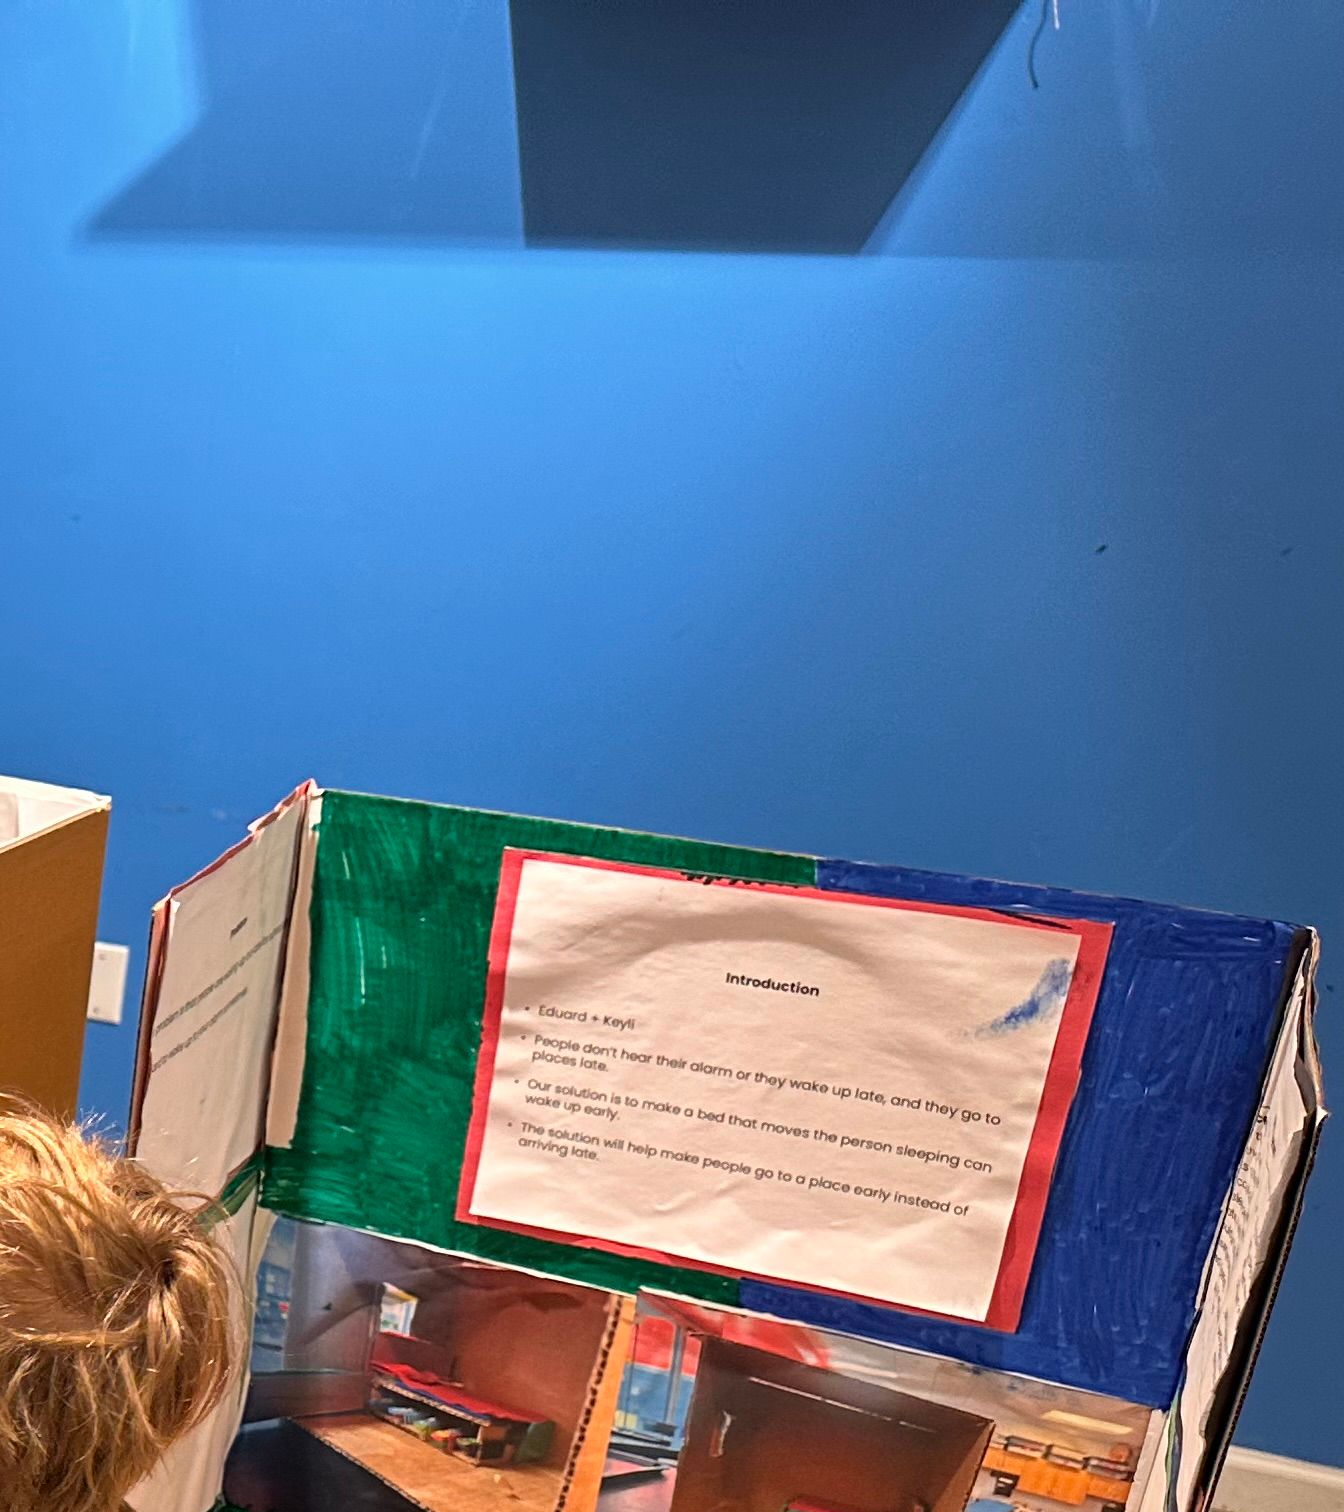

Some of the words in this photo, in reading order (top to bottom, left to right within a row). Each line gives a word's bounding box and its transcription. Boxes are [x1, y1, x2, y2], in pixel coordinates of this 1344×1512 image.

[725, 972, 820, 997] Introduction
[537, 1003, 588, 1022] Eduard
[603, 1016, 635, 1031] Keyli
[532, 1050, 576, 1066] places
[580, 1058, 608, 1072] late.
[534, 1033, 581, 1052] People
[582, 1043, 618, 1059] don't
[621, 1049, 652, 1063] hear
[656, 1056, 687, 1068] their
[690, 1062, 732, 1077] alarm
[736, 1071, 751, 1080] or
[755, 1072, 787, 1089] they
[790, 1080, 828, 1093] wake
[832, 1087, 851, 1099] up
[855, 1088, 886, 1105] late,
[891, 1097, 921, 1109] and
[926, 1101, 958, 1119] they
[961, 1110, 981, 1122] go
[986, 1114, 1001, 1125] to
[526, 1096, 560, 1108] wake
[564, 1102, 581, 1113] up
[584, 1106, 619, 1122] early.
[527, 1078, 552, 1093] Our
[555, 1086, 607, 1101] solution
[611, 1093, 621, 1104] is
[625, 1096, 638, 1107] to
[642, 1101, 681, 1115] make
[684, 1108, 693, 1117] a
[697, 1109, 725, 1123] bed
[729, 1115, 757, 1129] that
[761, 1122, 809, 1138] moves
[814, 1130, 837, 1142] the
[840, 1136, 892, 1152] person
[896, 1145, 960, 1168] sleeping
[964, 1159, 992, 1173] can
[518, 1138, 568, 1157] arriving
[571, 1146, 598, 1161] late.
[521, 1122, 544, 1135] The
[548, 1128, 600, 1147] solution
[604, 1139, 624, 1150] will
[627, 1142, 657, 1158] help
[660, 1150, 699, 1164] make
[702, 1158, 751, 1174] people
[755, 1168, 774, 1180] go
[778, 1171, 792, 1182] to
[796, 1176, 805, 1184] a
[809, 1177, 850, 1192] place
[854, 1186, 891, 1203] early
[894, 1191, 950, 1212] instead
[954, 1206, 969, 1216] of
